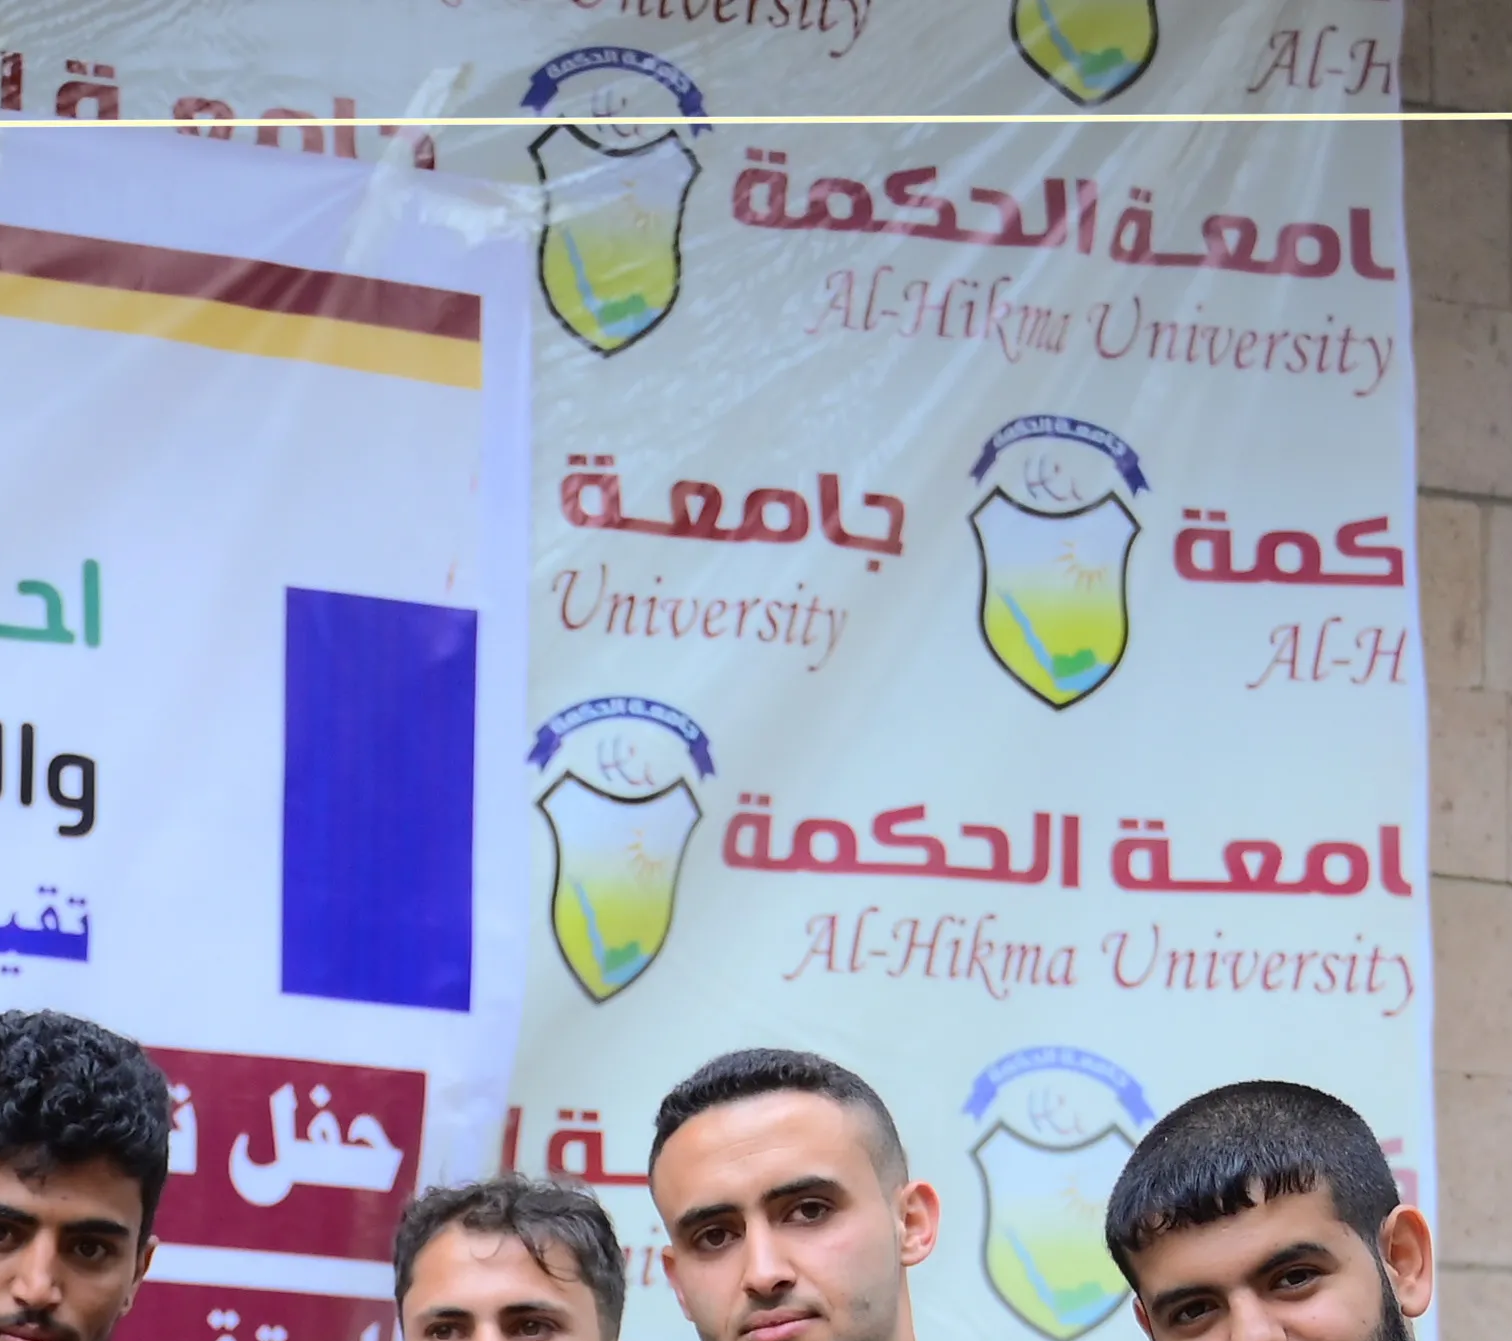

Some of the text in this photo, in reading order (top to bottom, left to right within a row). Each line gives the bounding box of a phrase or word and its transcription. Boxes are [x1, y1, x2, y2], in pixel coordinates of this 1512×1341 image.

[730, 147, 1395, 281] امعة الحكمة
[806, 267, 1394, 397] Al-Hikma University
[559, 454, 907, 574] جامعة
[1173, 508, 1405, 588] كمة
[550, 568, 850, 672] University
[723, 793, 1413, 897] امعة الحكمة
[784, 910, 1078, 1003] Al-Hikma
[228, 1082, 404, 1207] حفل
